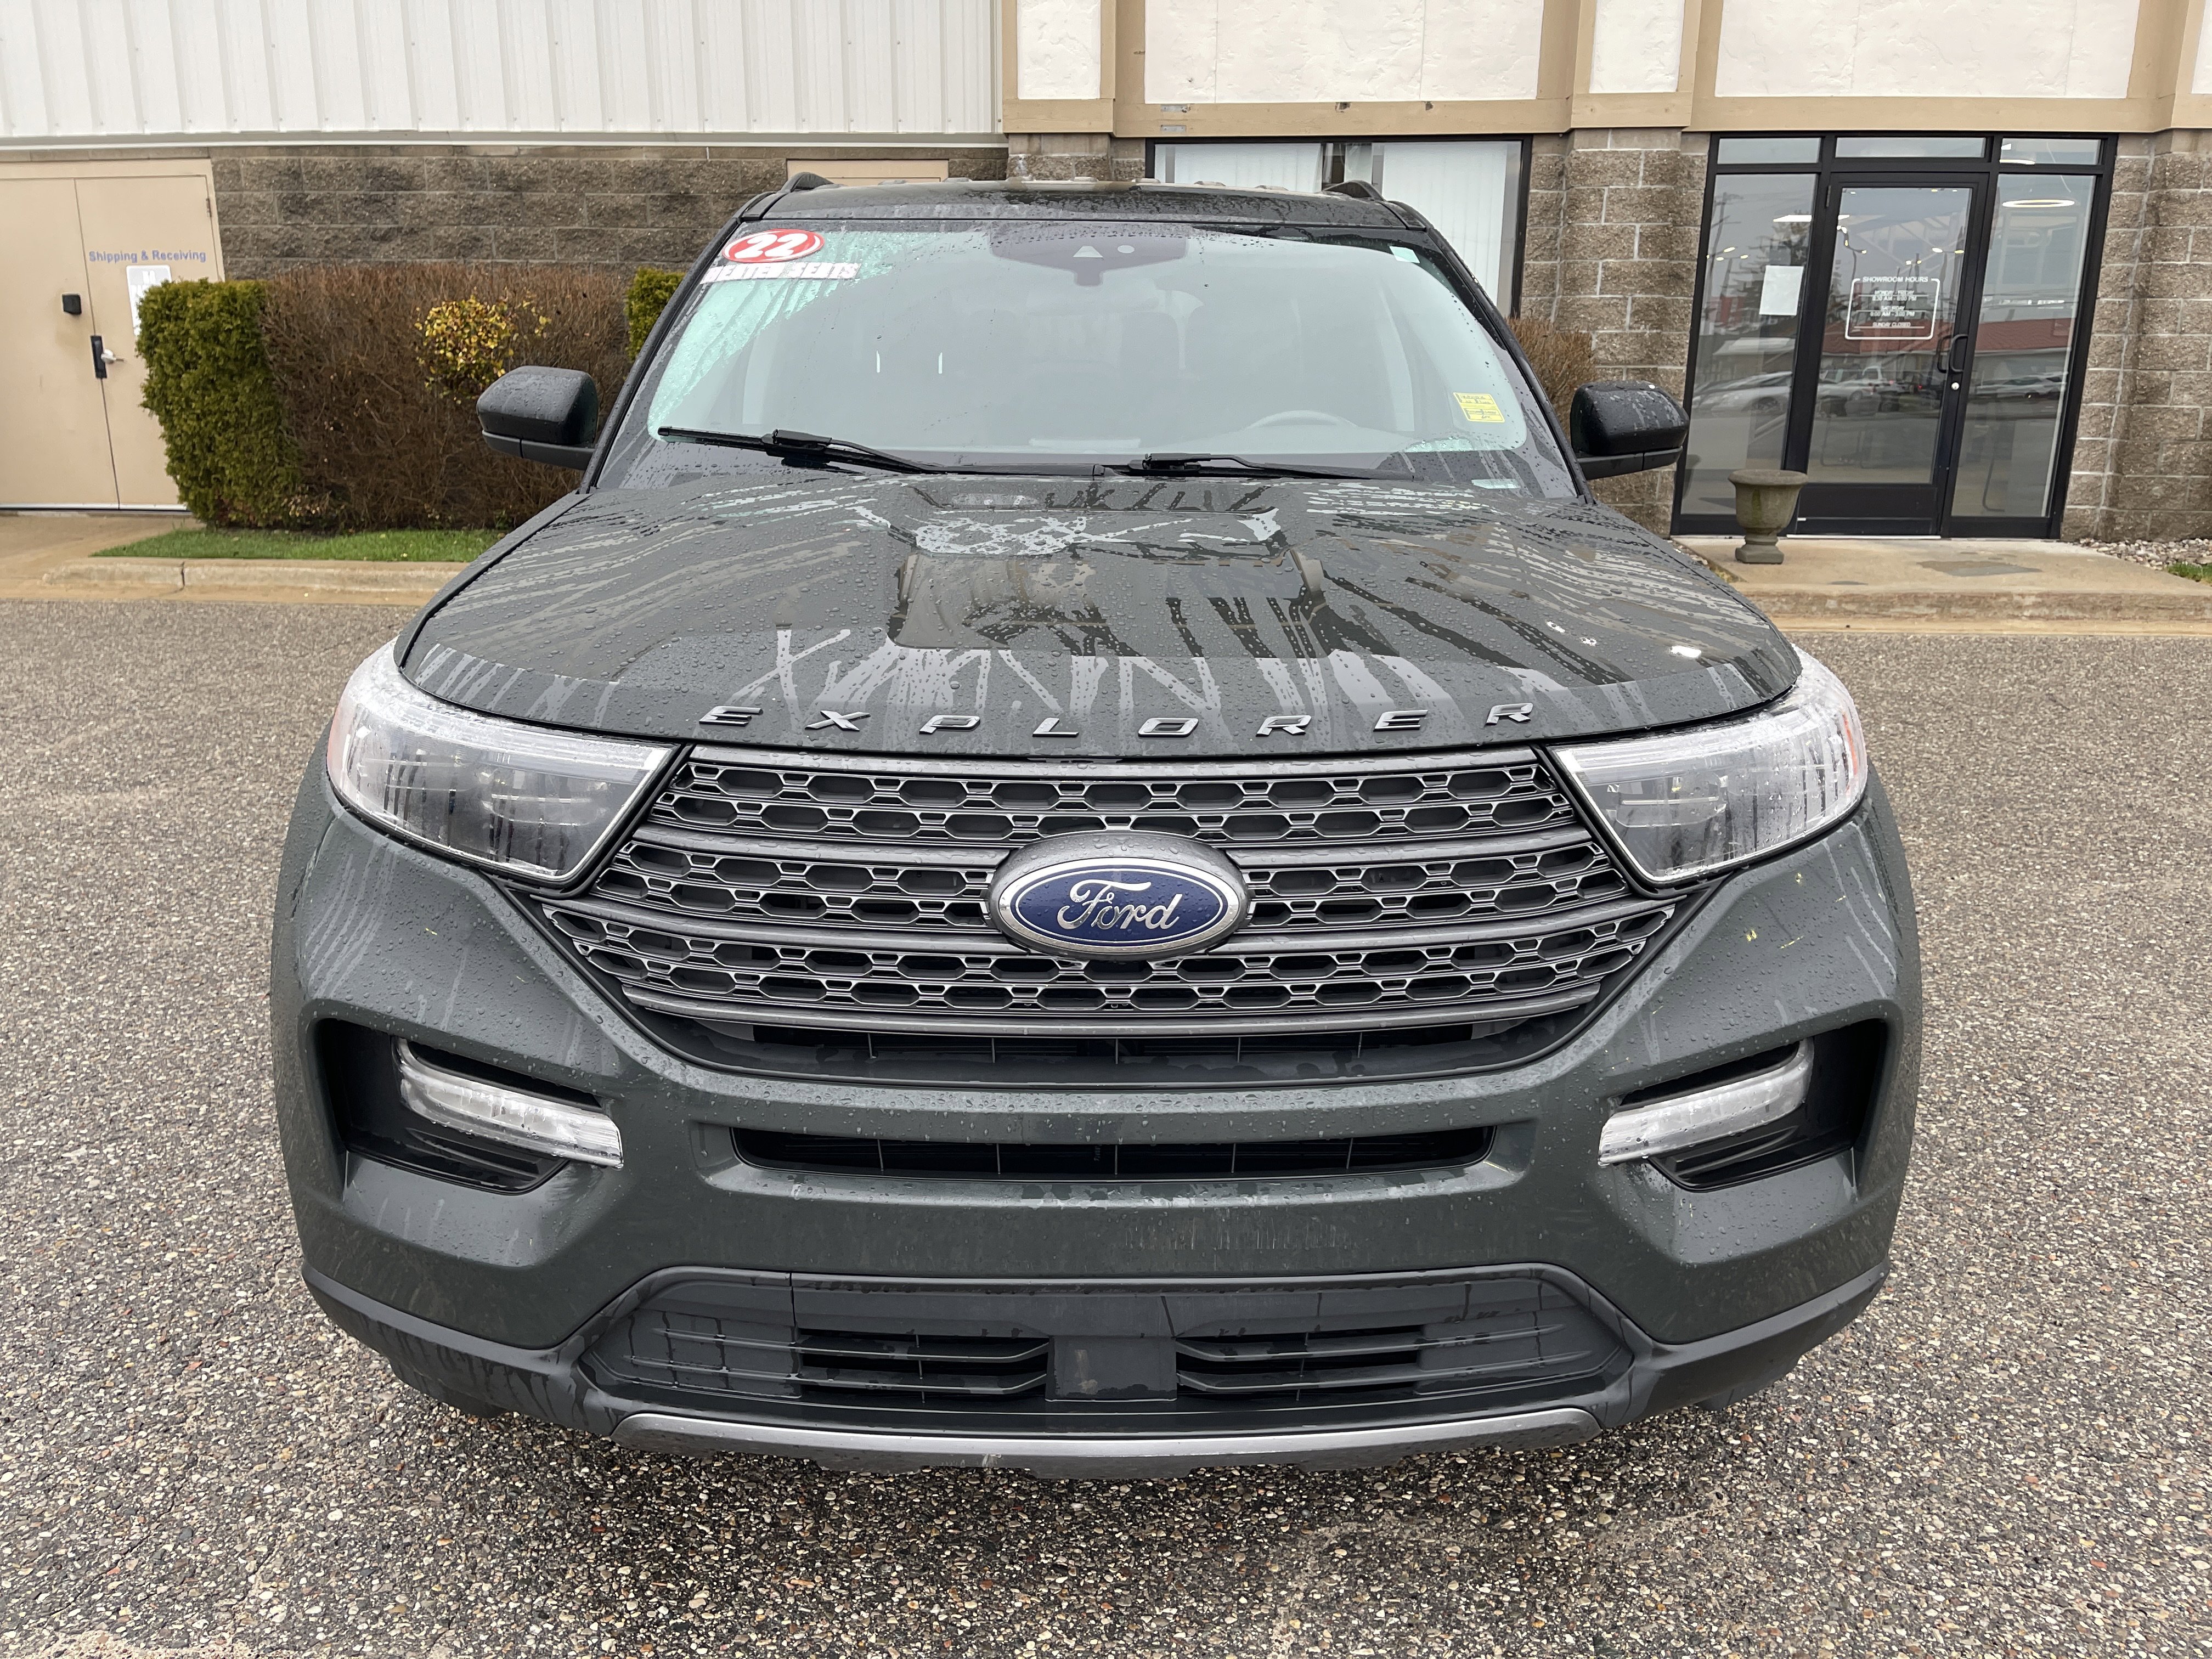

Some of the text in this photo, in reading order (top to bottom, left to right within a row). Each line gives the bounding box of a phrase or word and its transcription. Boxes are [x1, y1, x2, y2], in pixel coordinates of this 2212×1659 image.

[89, 249, 207, 263] Shipping & Receiving
[734, 233, 809, 259] 22
[697, 701, 1534, 738] EXPLORER
[1057, 879, 1183, 930] Ford
